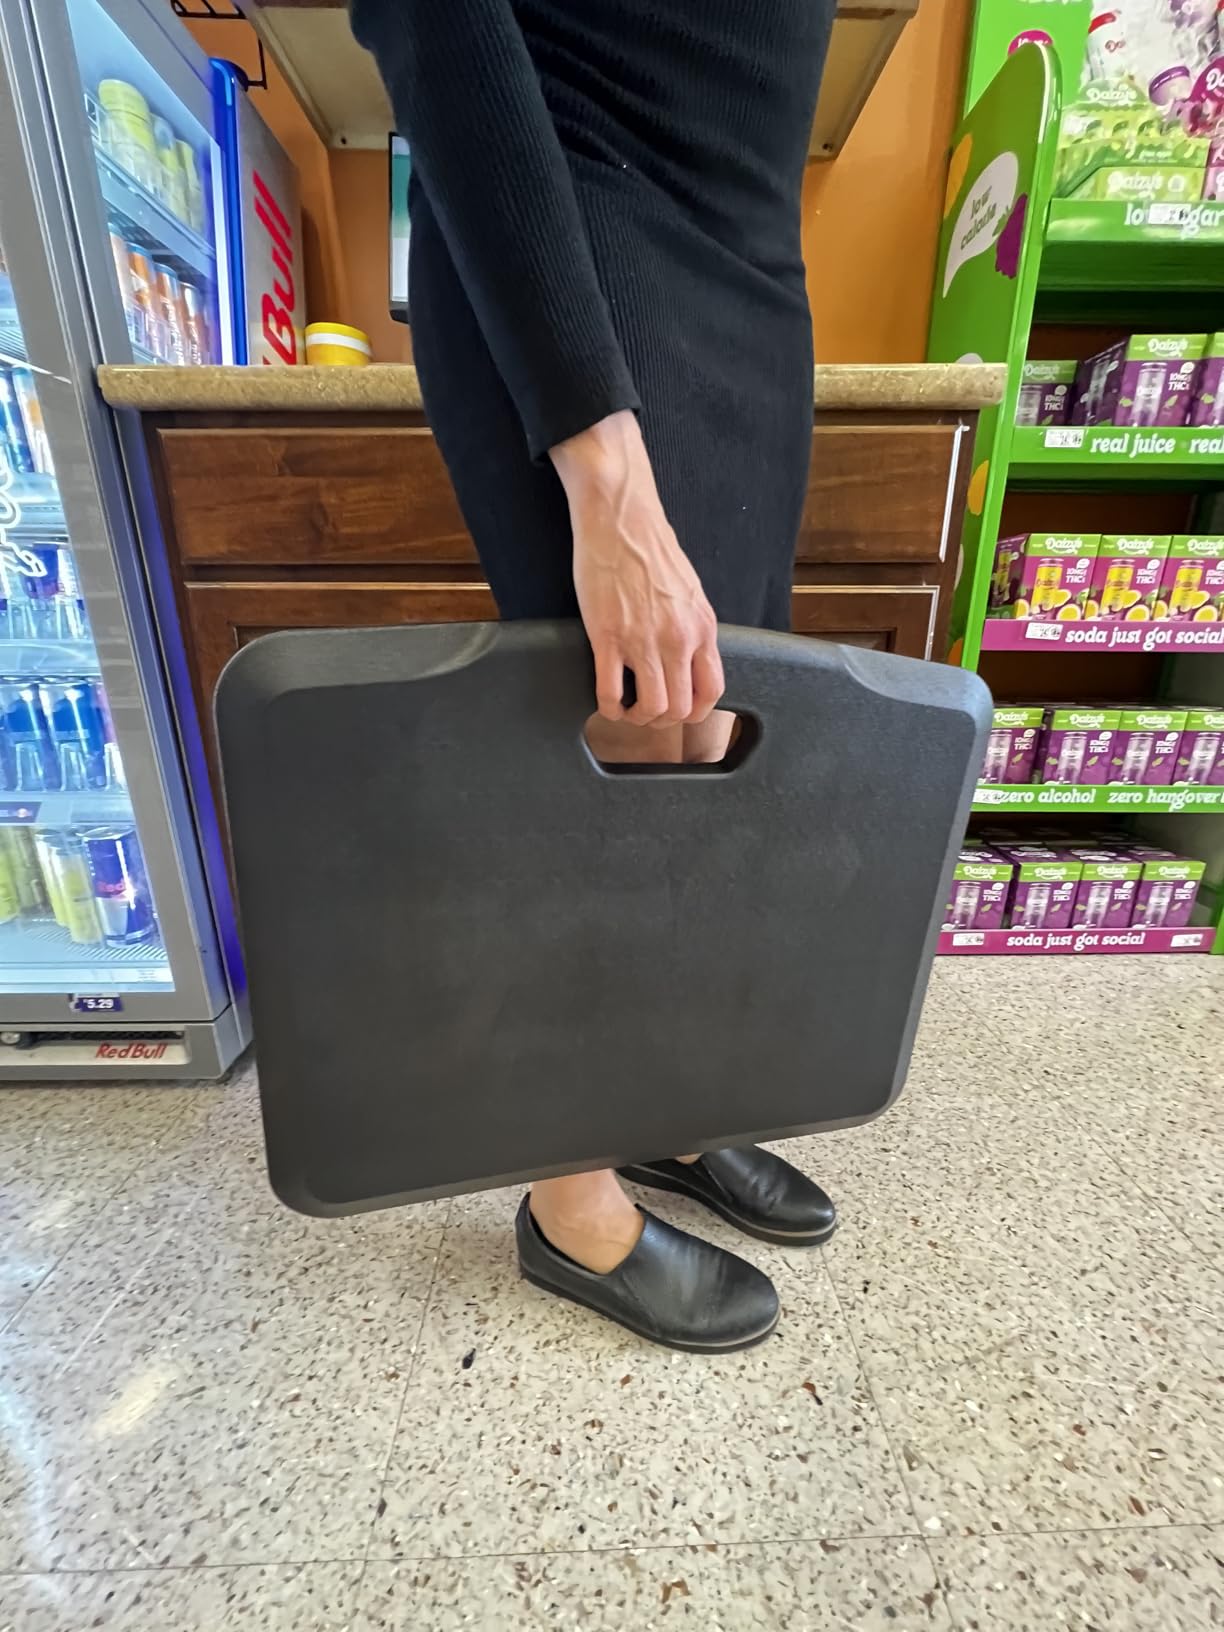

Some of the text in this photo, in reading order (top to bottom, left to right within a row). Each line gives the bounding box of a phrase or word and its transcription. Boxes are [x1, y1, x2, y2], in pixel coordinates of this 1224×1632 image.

[1123, 203, 1148, 226] lo
[253, 169, 298, 365] Bull
[1090, 432, 1130, 453] real
[1129, 432, 1176, 458] juice
[1065, 626, 1108, 643] soda
[1107, 626, 1142, 648] just
[1142, 626, 1173, 651] got
[1174, 627, 1224, 644] social
[1001, 790, 1035, 804] zero
[1038, 788, 1097, 804] alcohol
[1107, 788, 1224, 812] zero hangover
[1006, 932, 1146, 952] soda just got social
[95, 1042, 169, 1059] Red Bull
